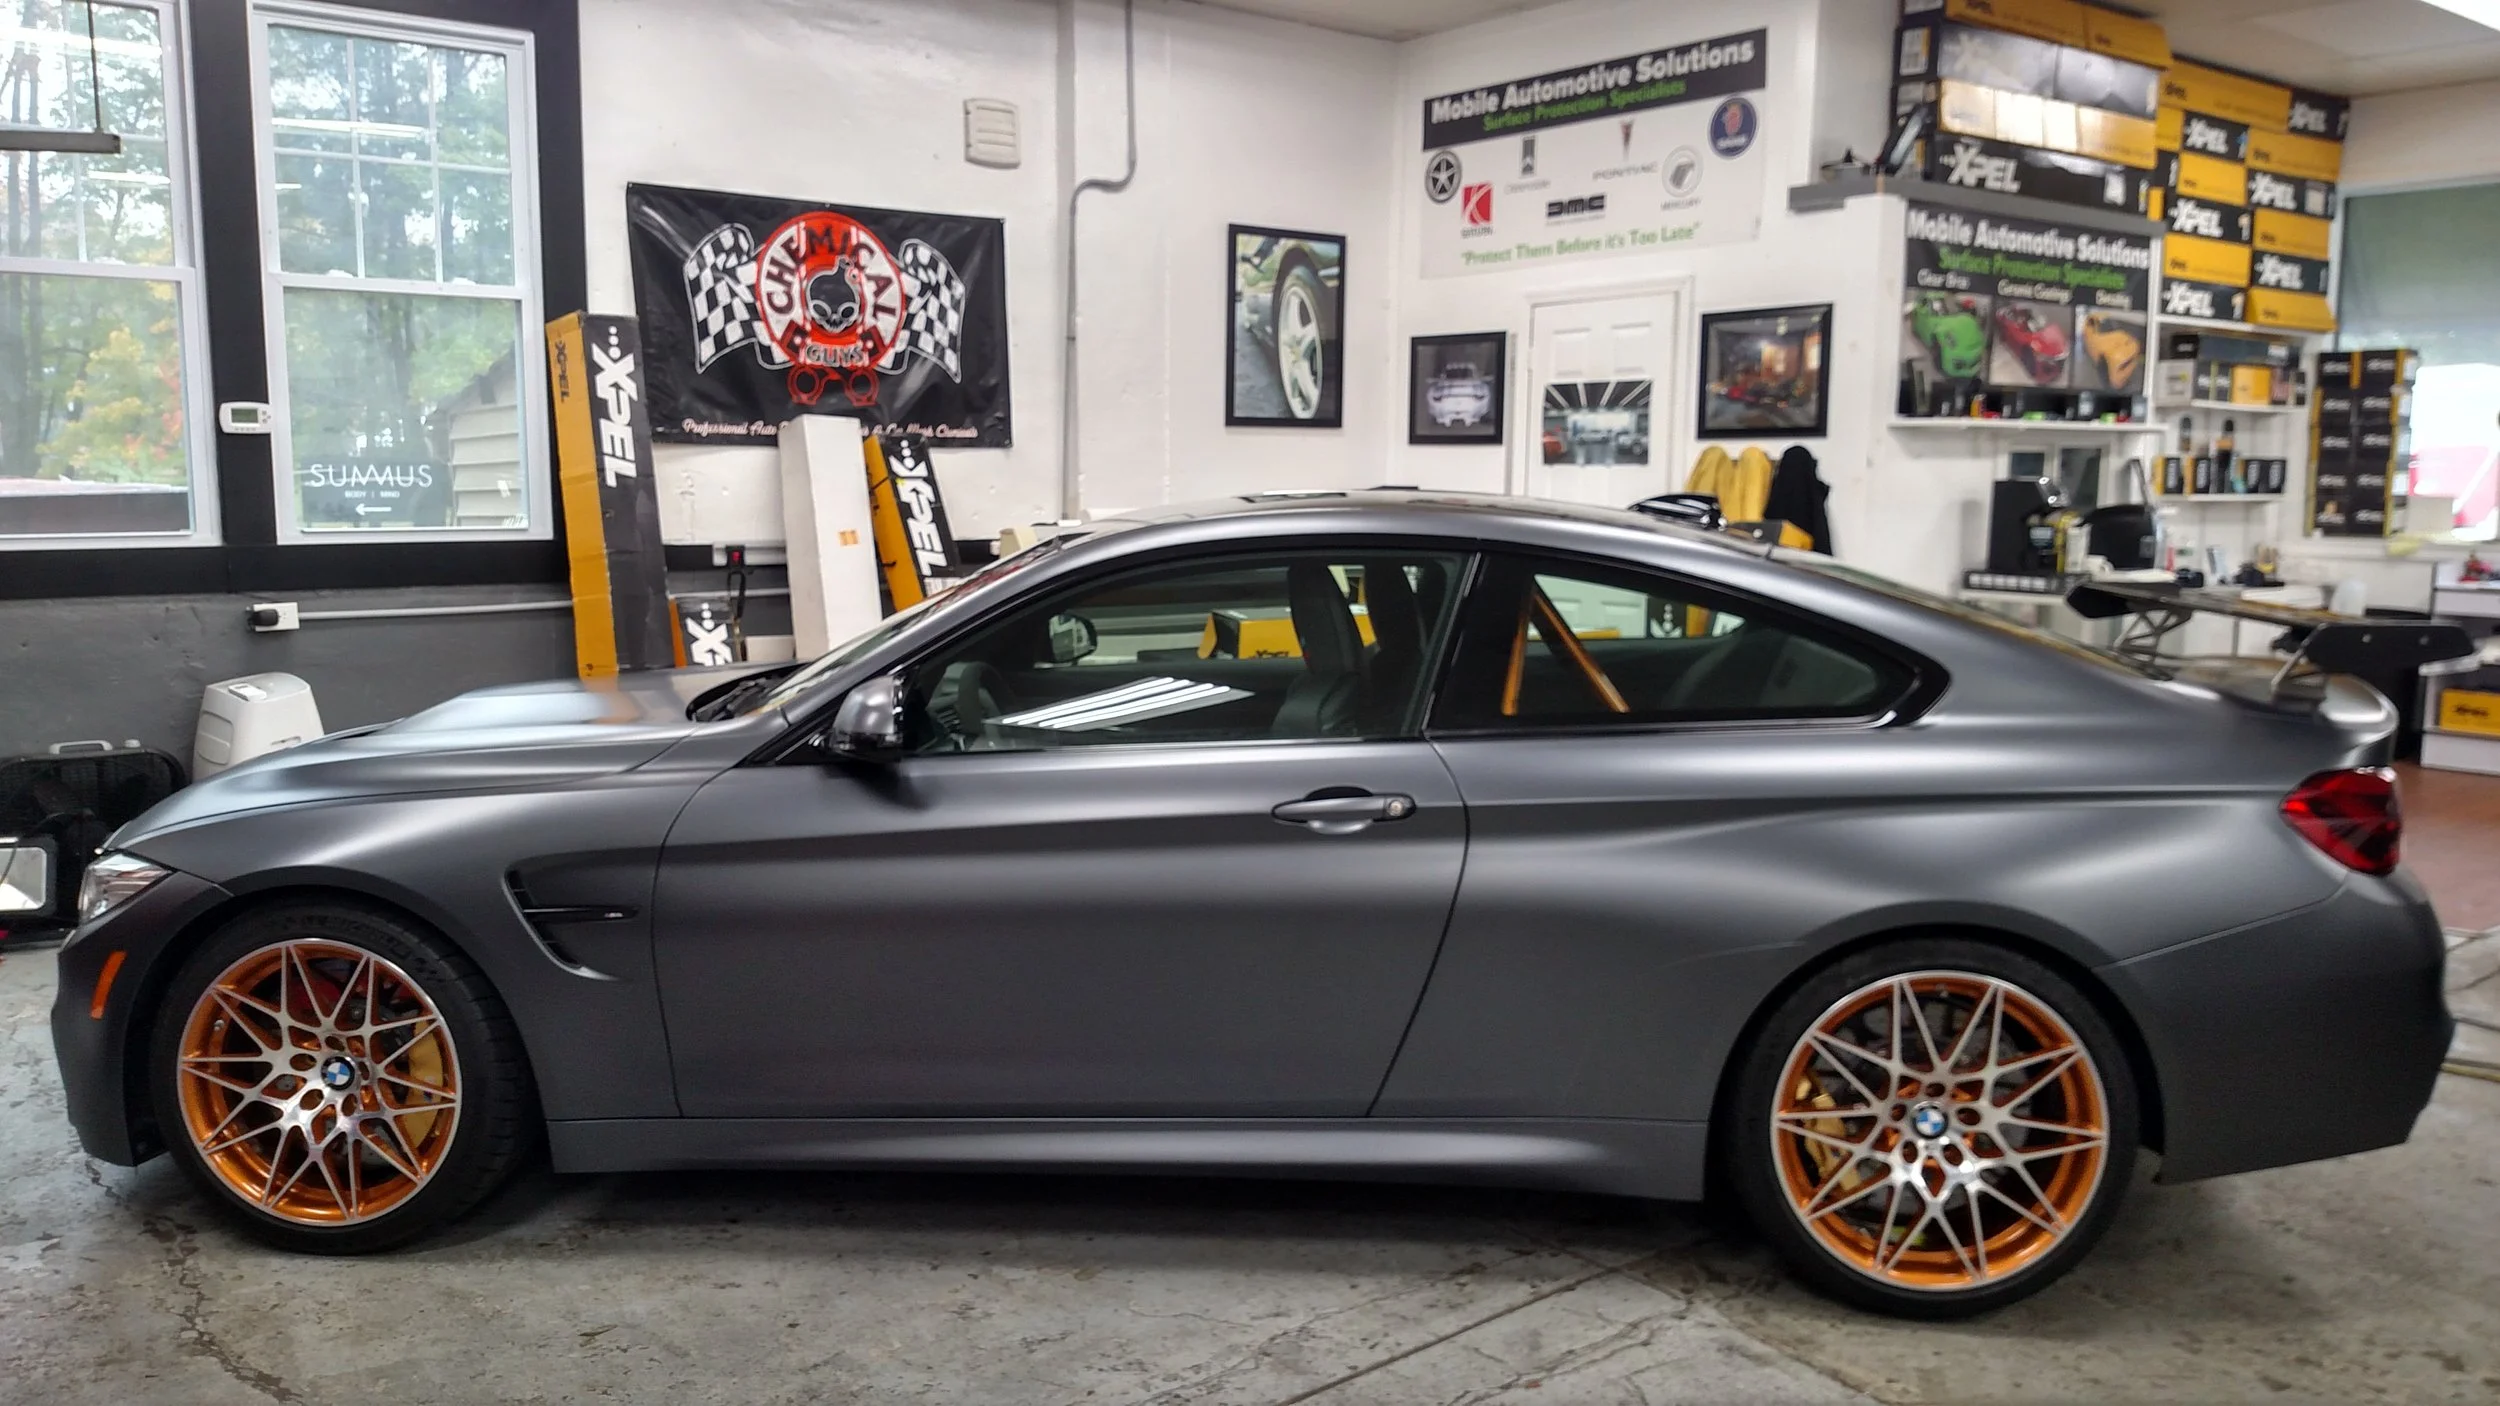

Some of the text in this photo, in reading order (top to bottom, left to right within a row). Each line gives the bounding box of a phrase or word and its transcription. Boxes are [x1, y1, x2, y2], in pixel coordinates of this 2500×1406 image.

[1431, 39, 1755, 124] Mobile Automotive Solutions
[765, 225, 897, 321] CHEMICAL
[1907, 209, 2149, 269] Mobile Automotive Solutions
[805, 344, 863, 367] GUYS
[591, 343, 638, 488] XPEL
[888, 455, 948, 576] XPEL
